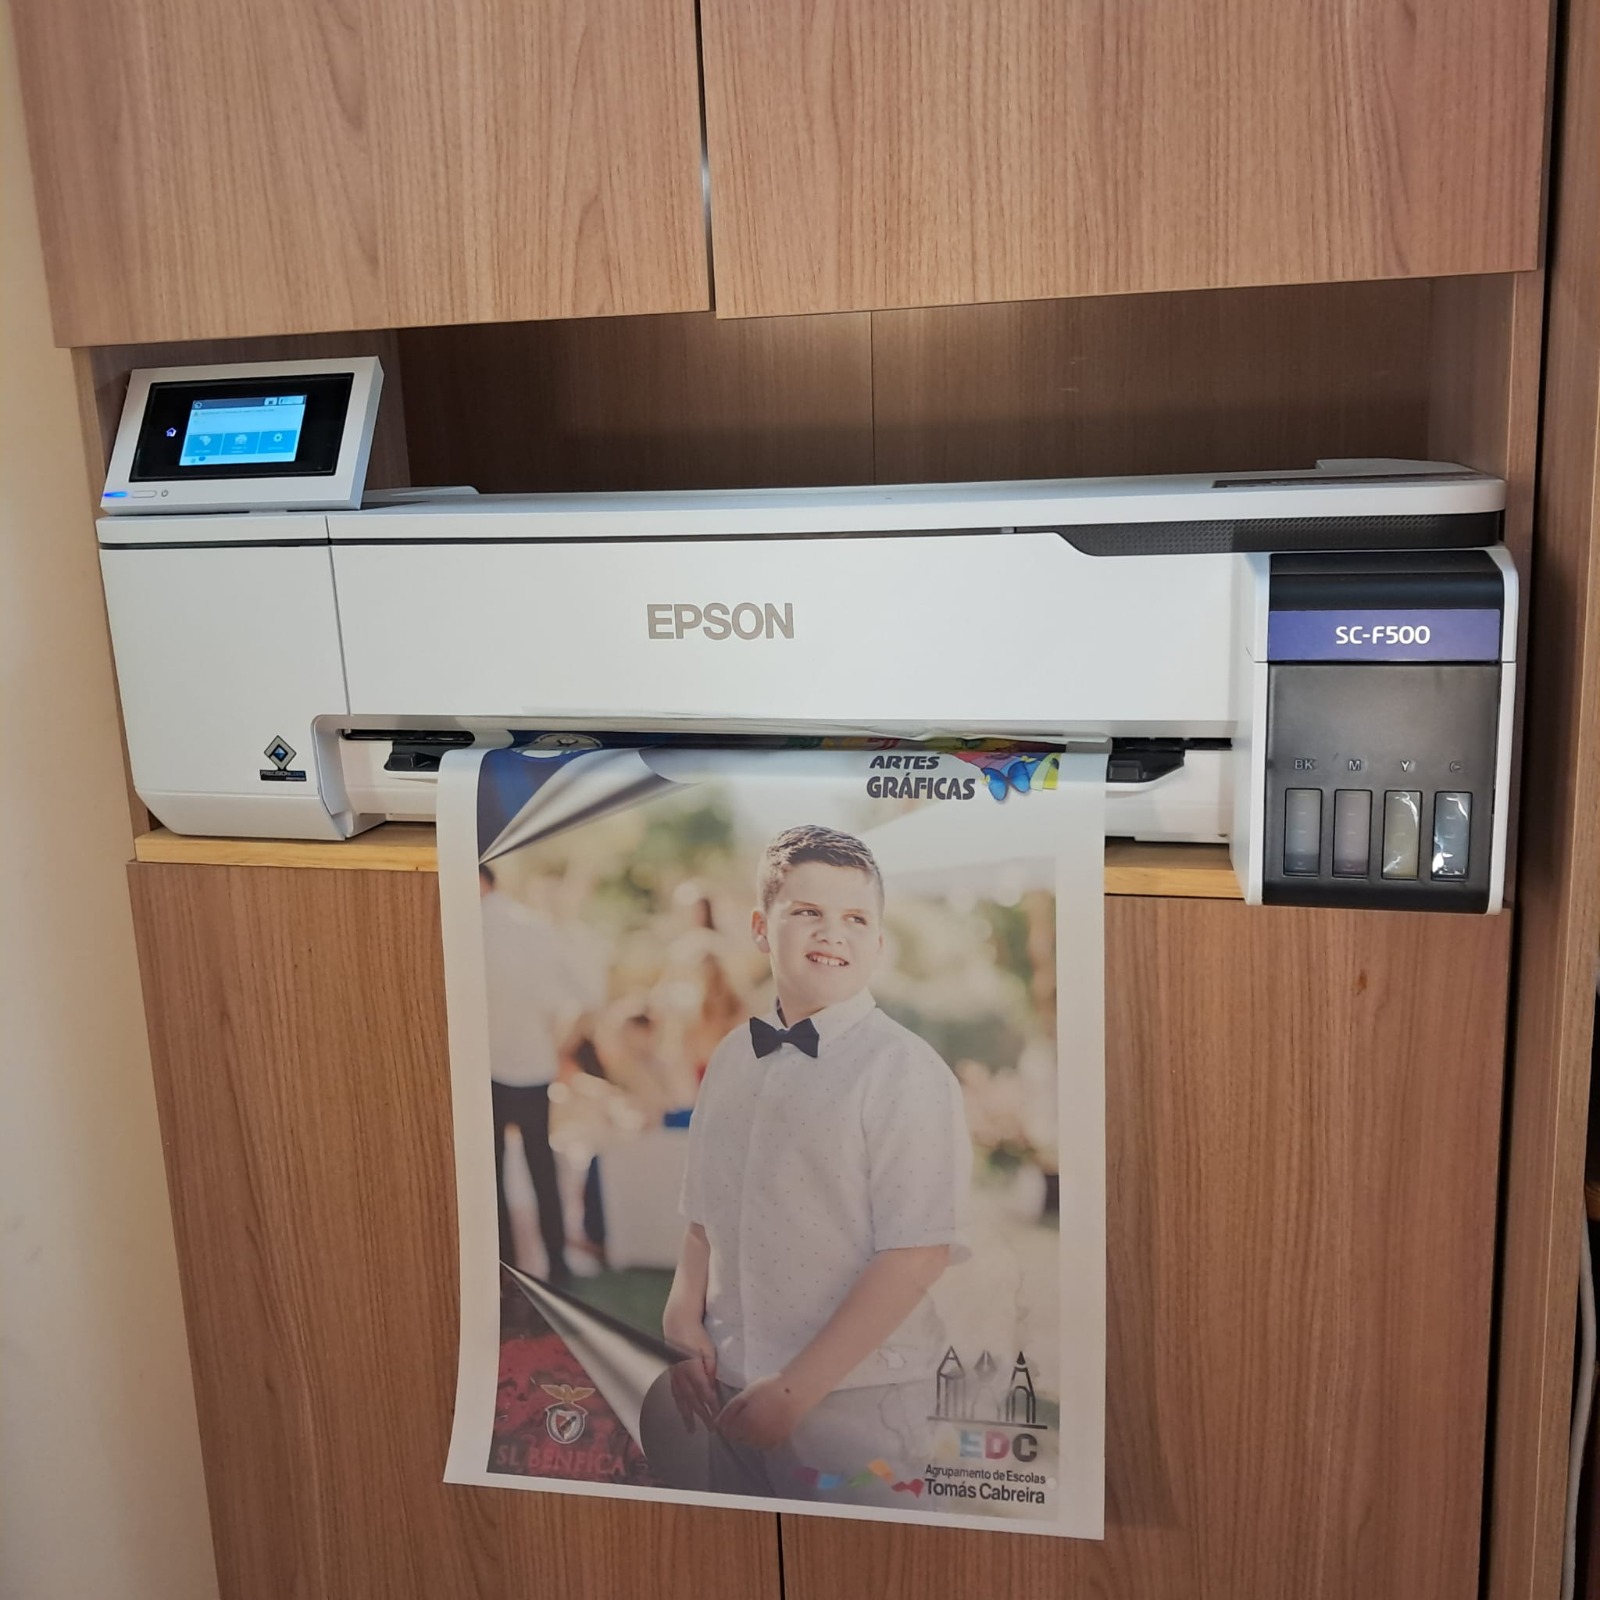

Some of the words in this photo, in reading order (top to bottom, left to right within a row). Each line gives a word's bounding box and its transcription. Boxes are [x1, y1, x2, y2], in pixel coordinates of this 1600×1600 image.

[647, 602, 795, 641] EPSON
[1335, 625, 1431, 645] SC-F500
[869, 755, 940, 770] ARTES
[1294, 758, 1315, 771] BK
[1349, 760, 1362, 771] M
[1401, 760, 1411, 772] Y
[866, 773, 976, 801] GRÁFICAS
[925, 1464, 992, 1480] Agrupamento
[993, 1470, 1006, 1481] de
[1006, 1471, 1046, 1485] Escolas
[924, 1478, 977, 1499] Tomás
[979, 1482, 1046, 1505] Cabreira
